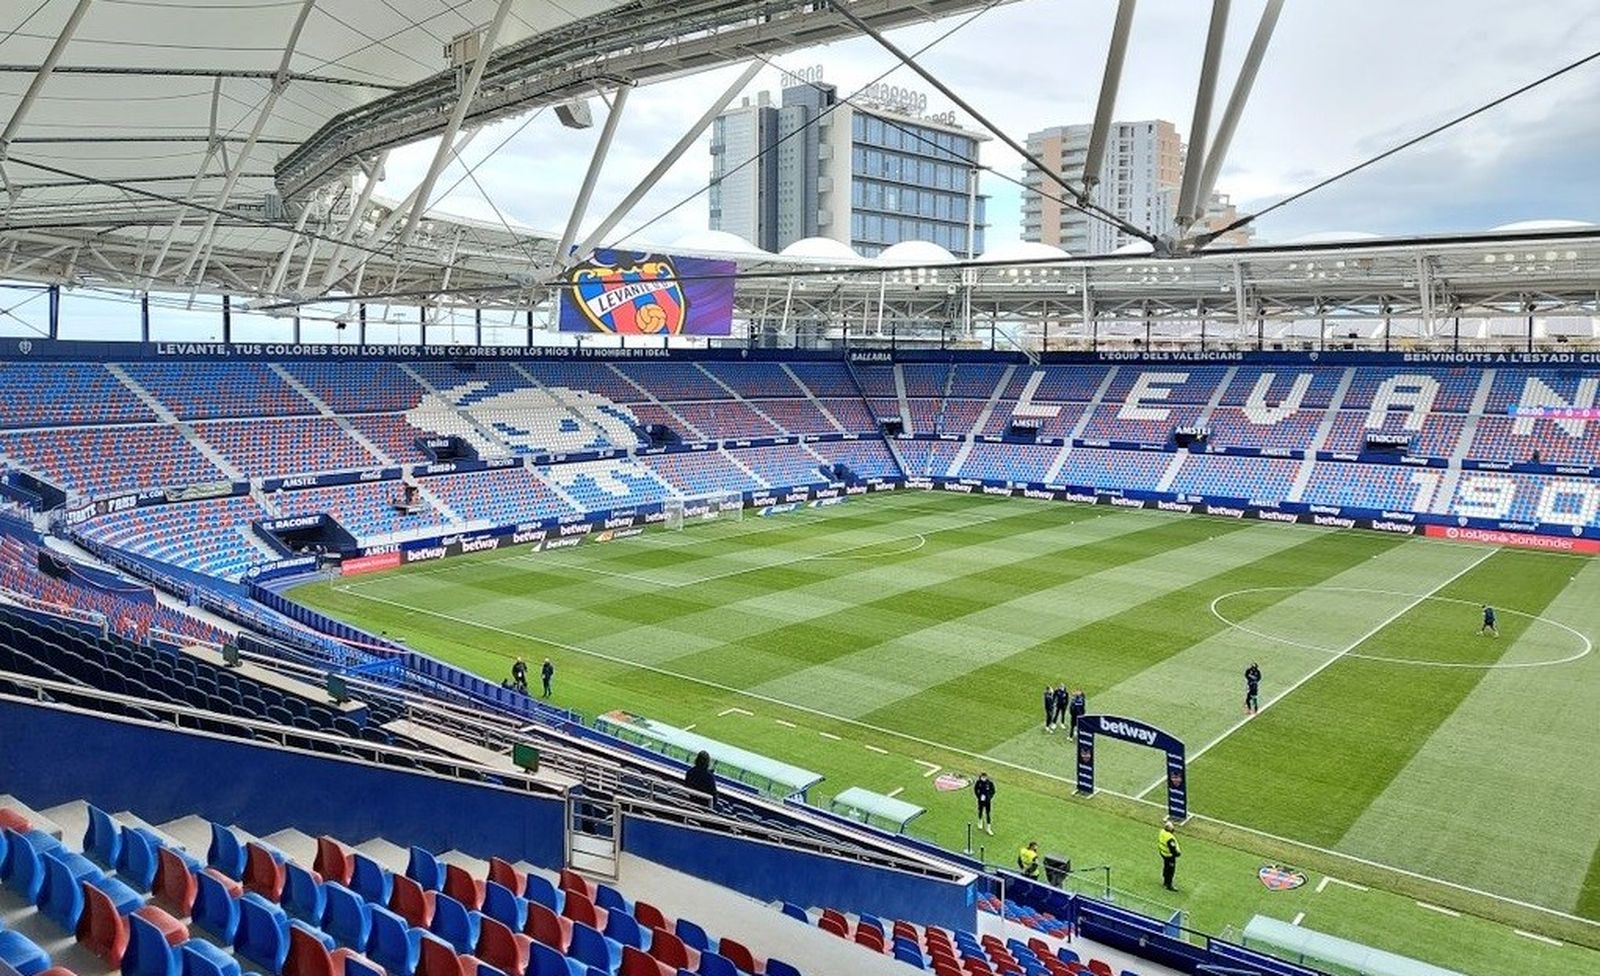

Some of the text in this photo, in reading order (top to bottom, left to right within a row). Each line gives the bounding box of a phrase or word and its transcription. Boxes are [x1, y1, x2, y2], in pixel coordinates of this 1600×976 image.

[598, 284, 652, 312] LEVANTE
[157, 344, 231, 357] LEVANTE,
[235, 344, 262, 355] TUS
[266, 344, 328, 356] COLORES
[331, 345, 358, 356] SON
[361, 346, 385, 356] LOS
[424, 346, 445, 356] TUS
[500, 347, 521, 357] SON
[523, 347, 543, 357] LOS
[572, 348, 577, 357] Y
[580, 348, 593, 357] TU
[594, 348, 631, 357] NOMBRE
[634, 348, 643, 357] MI
[645, 348, 671, 358] IDEAL
[1100, 352, 1243, 360] L'EQUIP DELS VALENCIANS
[1404, 353, 1492, 362] BENVINGUTS
[1496, 353, 1507, 362] A
[1511, 353, 1575, 363] L'ESTADI
[1367, 434, 1412, 444] macron
[1024, 489, 1055, 501] betway
[1066, 493, 1098, 504] betway
[1111, 496, 1145, 509] betway
[1158, 500, 1193, 514] betway
[1207, 504, 1245, 519] betway
[1259, 509, 1298, 524] betway
[605, 516, 635, 529] betway
[1314, 515, 1356, 529] betway
[1372, 519, 1416, 535] betway
[559, 523, 593, 536] betway
[513, 530, 547, 544] betway
[1509, 533, 1574, 549] Santander
[462, 537, 499, 553] betway
[408, 546, 447, 562] betway
[1099, 717, 1157, 745] betway
